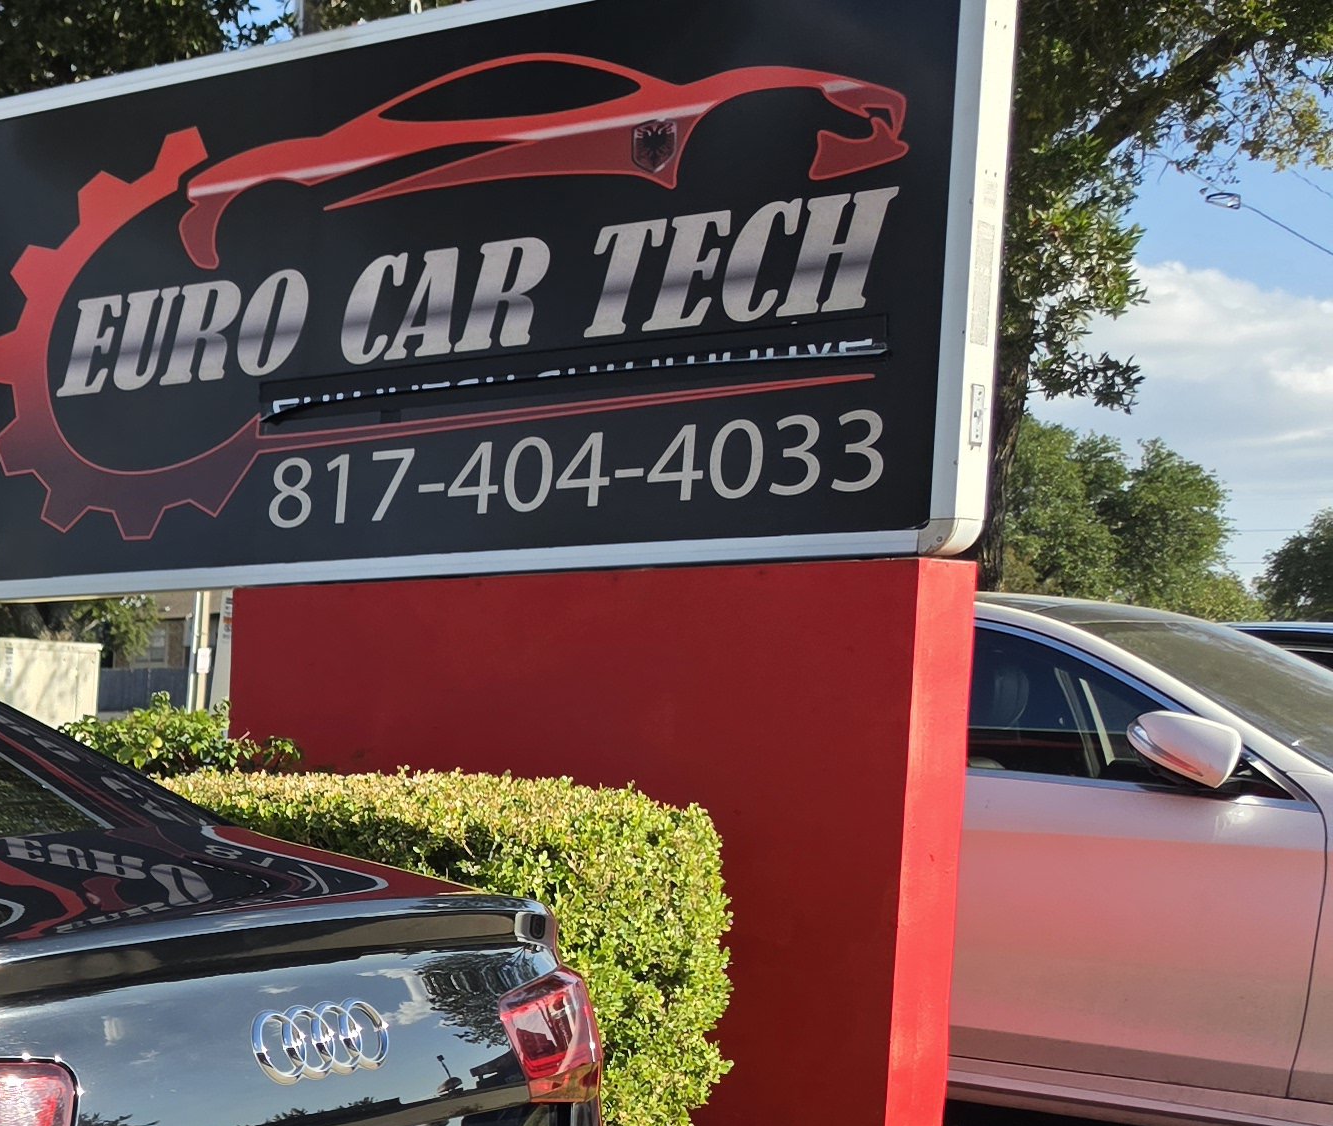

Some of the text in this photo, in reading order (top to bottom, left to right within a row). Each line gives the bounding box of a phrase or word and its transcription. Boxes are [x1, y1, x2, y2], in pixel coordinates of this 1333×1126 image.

[56, 268, 310, 398] EURO
[340, 235, 552, 366] CAR
[583, 186, 901, 339] TECH
[267, 408, 886, 529] 817-404-4033
